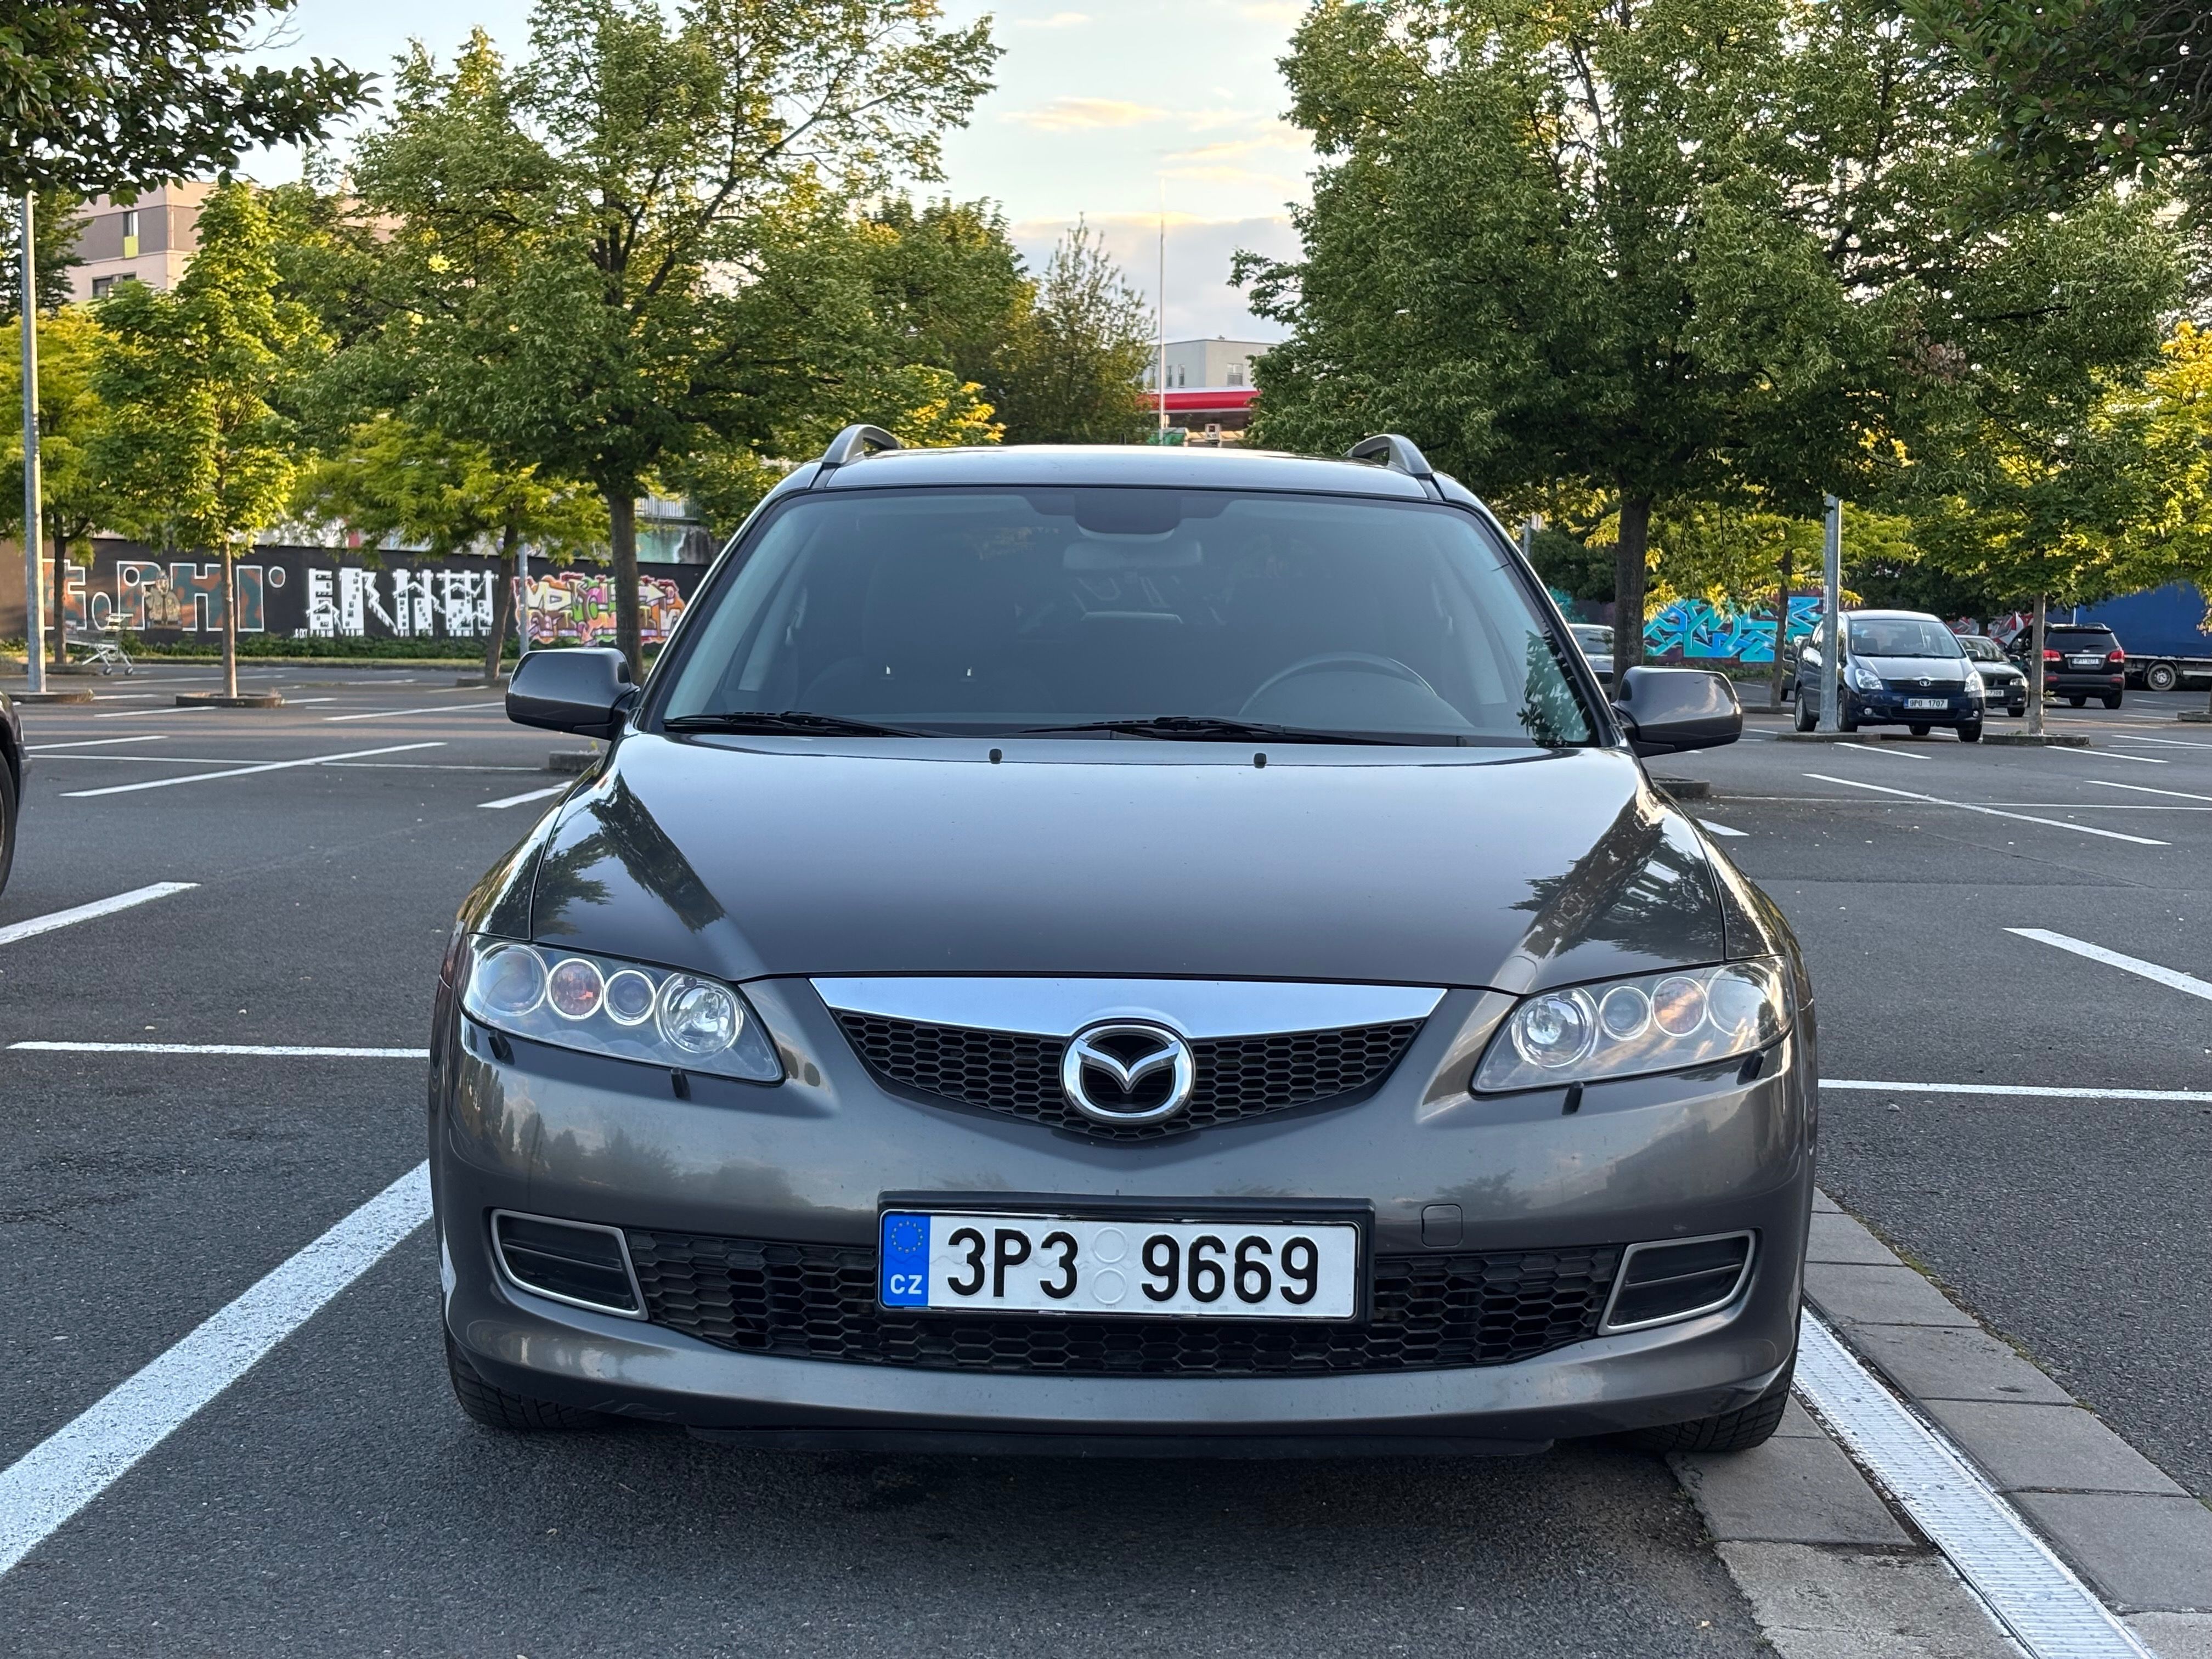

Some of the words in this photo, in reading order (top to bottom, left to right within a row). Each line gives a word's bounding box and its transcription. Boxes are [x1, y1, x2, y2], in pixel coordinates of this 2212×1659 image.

[890, 1273, 923, 1295] CZ
[947, 1227, 1079, 1300] 3P3
[1141, 1234, 1319, 1305] 9669
